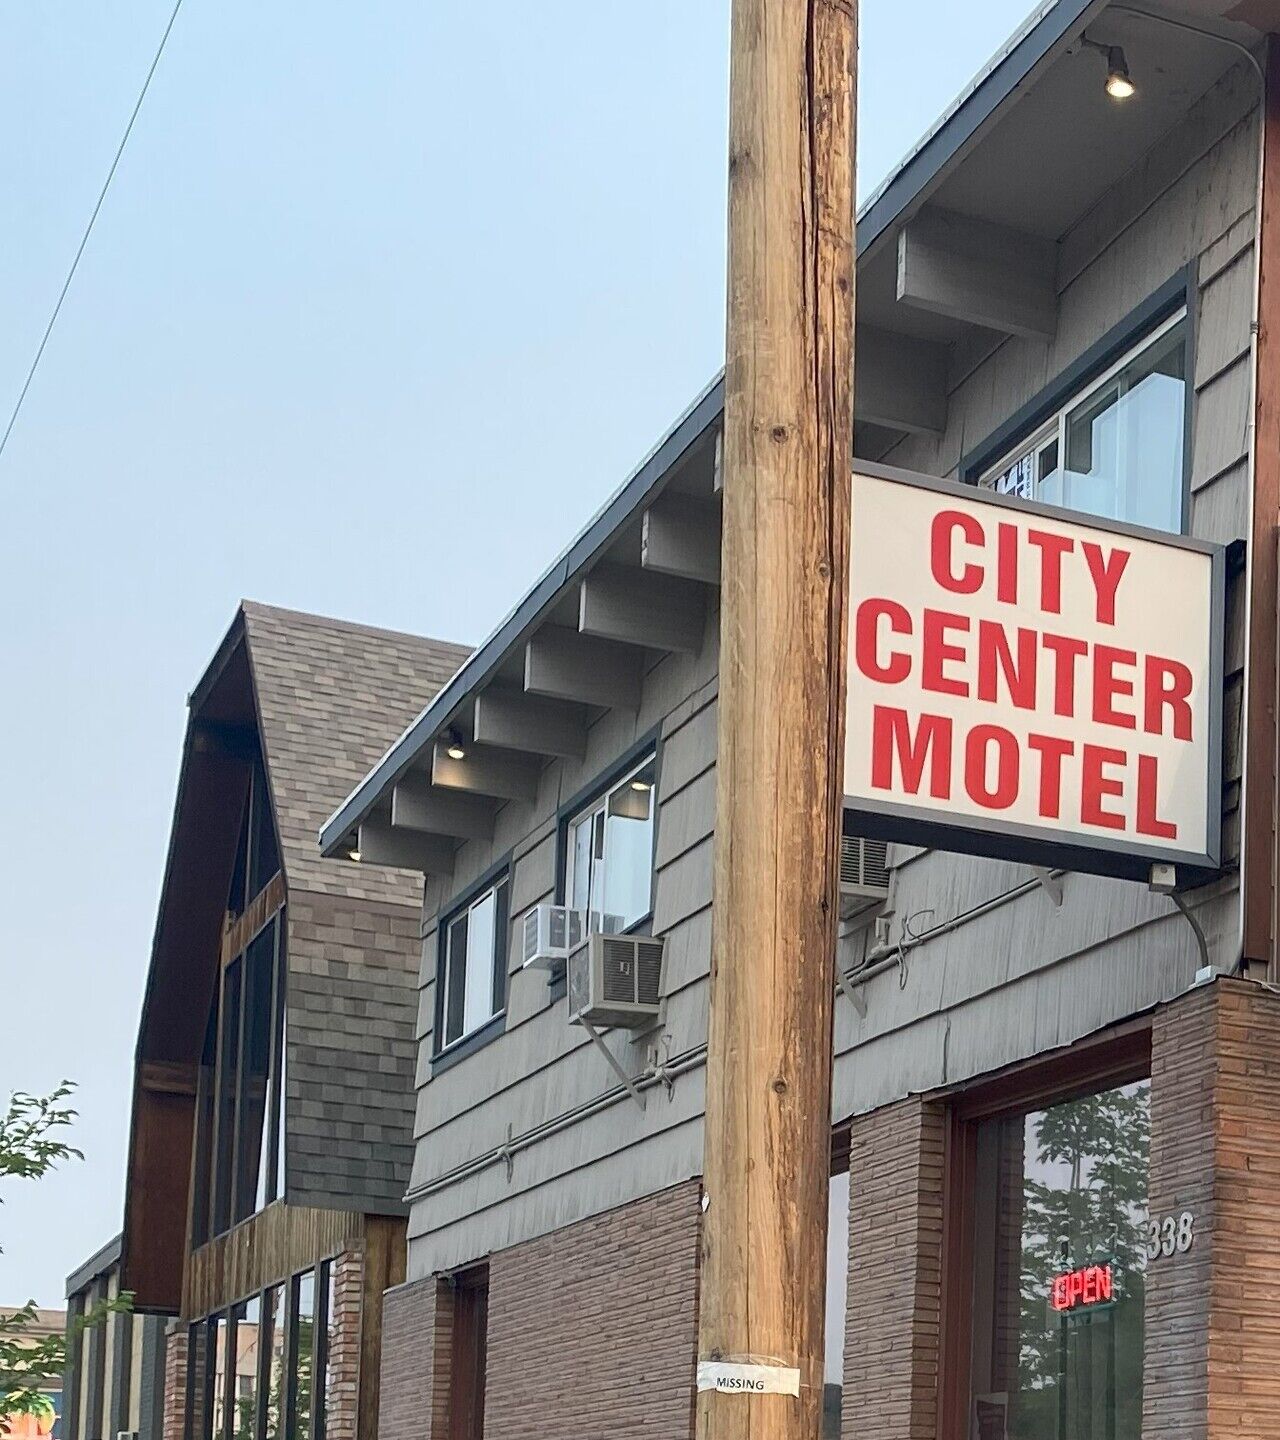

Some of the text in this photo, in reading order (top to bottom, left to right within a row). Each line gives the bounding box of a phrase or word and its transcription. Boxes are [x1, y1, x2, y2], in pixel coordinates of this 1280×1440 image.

[931, 509, 1131, 627] CITY
[855, 597, 1194, 743] CENTER
[870, 704, 1179, 841] MOTEL
[1147, 1211, 1194, 1260] 338
[1052, 1263, 1113, 1312] OPEN
[716, 1377, 765, 1390] MISSING
